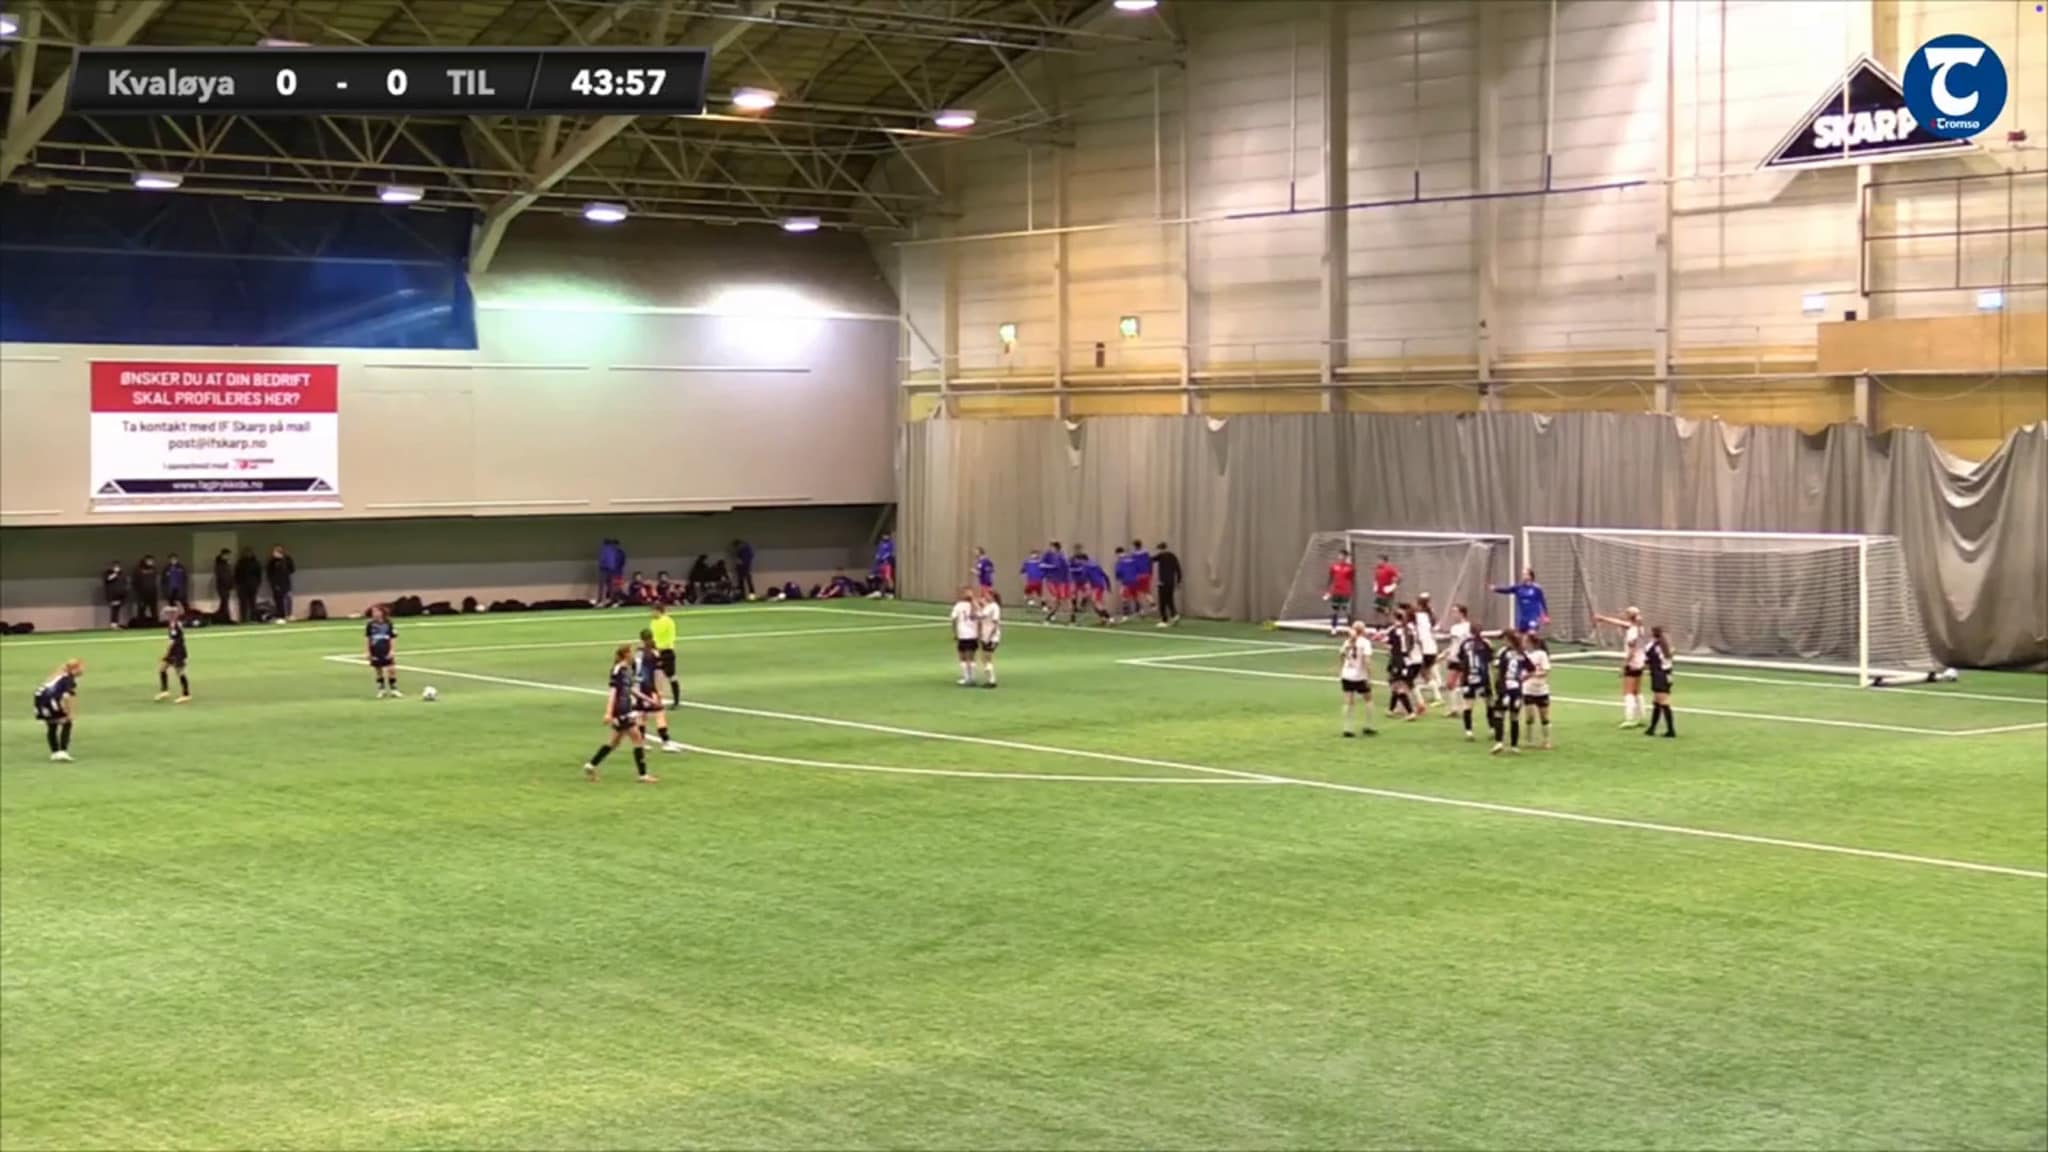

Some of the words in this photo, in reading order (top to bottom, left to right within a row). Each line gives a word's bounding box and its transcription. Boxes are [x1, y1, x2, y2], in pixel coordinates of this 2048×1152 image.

[1812, 106, 1919, 149] SKARP
[120, 371, 179, 386] ØNSKER
[183, 372, 203, 386] DU
[205, 372, 223, 386] AT
[226, 373, 250, 386] DIN
[253, 373, 311, 387] BEDRIFT
[132, 391, 172, 405] SKAL
[175, 392, 262, 405] PROFILERES
[264, 392, 301, 405] HER?
[122, 420, 137, 432] Ta
[140, 420, 187, 432] kontakt
[190, 421, 216, 432] med
[219, 421, 231, 431] IF
[233, 421, 267, 434] Skarp
[269, 419, 284, 434] på
[286, 420, 311, 432] mail
[168, 437, 267, 451] post@ifskarp.no
